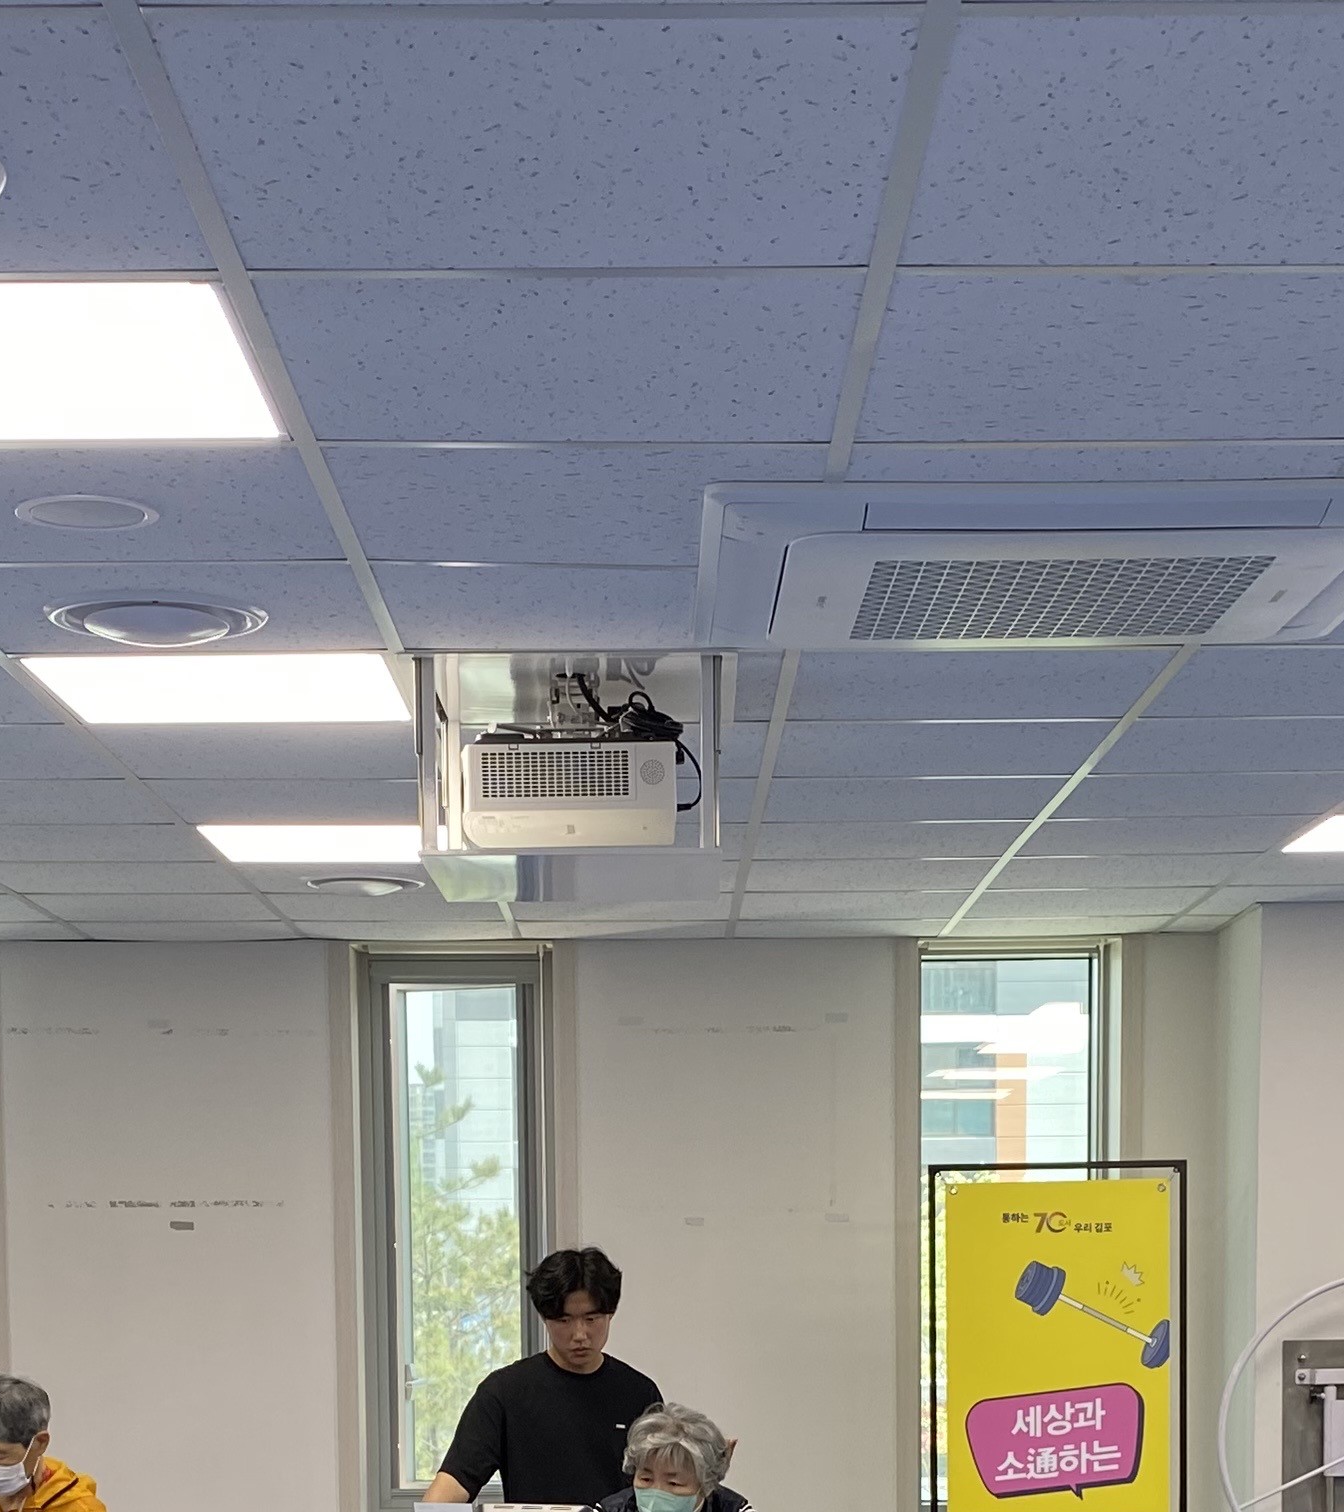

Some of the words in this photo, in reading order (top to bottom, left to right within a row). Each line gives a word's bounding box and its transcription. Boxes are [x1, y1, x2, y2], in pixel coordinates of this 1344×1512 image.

[1002, 1213, 1028, 1223] 통하는
[1074, 1223, 1092, 1233] 우리
[1095, 1222, 1112, 1233] 김포
[1011, 1398, 1106, 1437] 세상과
[995, 1441, 1122, 1481] 소通하는
